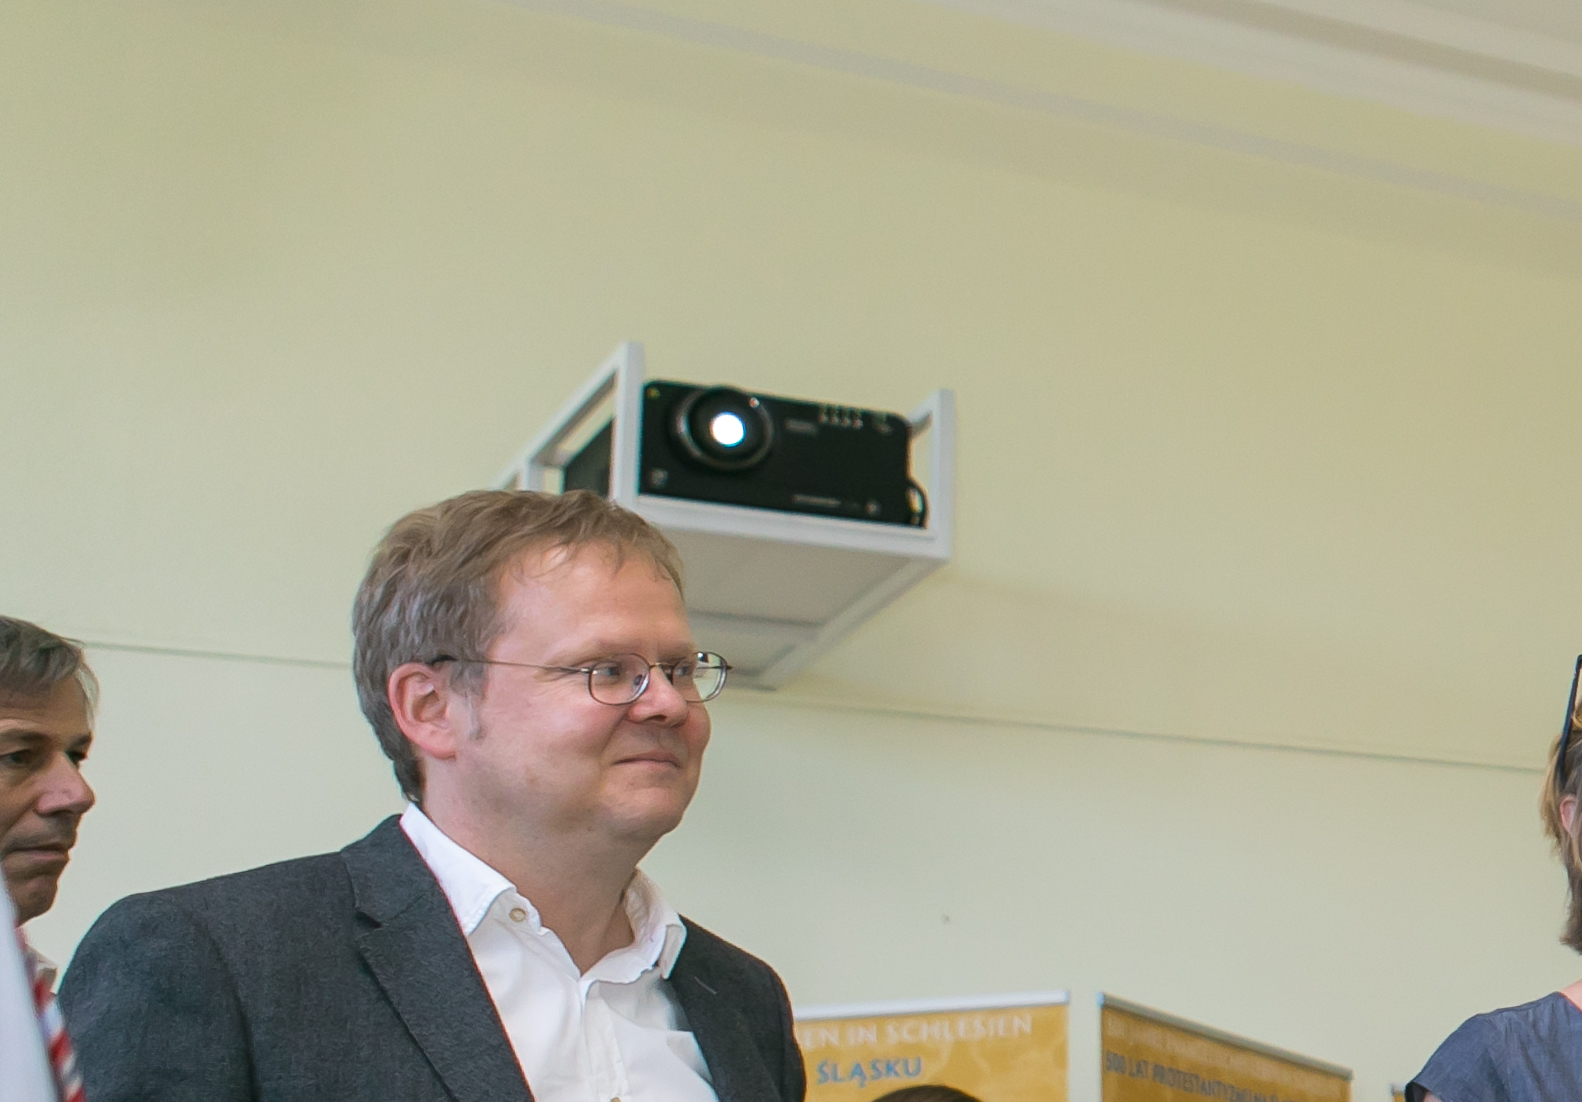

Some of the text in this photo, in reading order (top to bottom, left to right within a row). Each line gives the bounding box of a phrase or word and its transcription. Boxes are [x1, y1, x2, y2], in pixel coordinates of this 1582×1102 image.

[847, 1022, 878, 1047] IN
[886, 1013, 1032, 1045] SCHLESIEN
[817, 1057, 922, 1088] ŚLĄSKU
